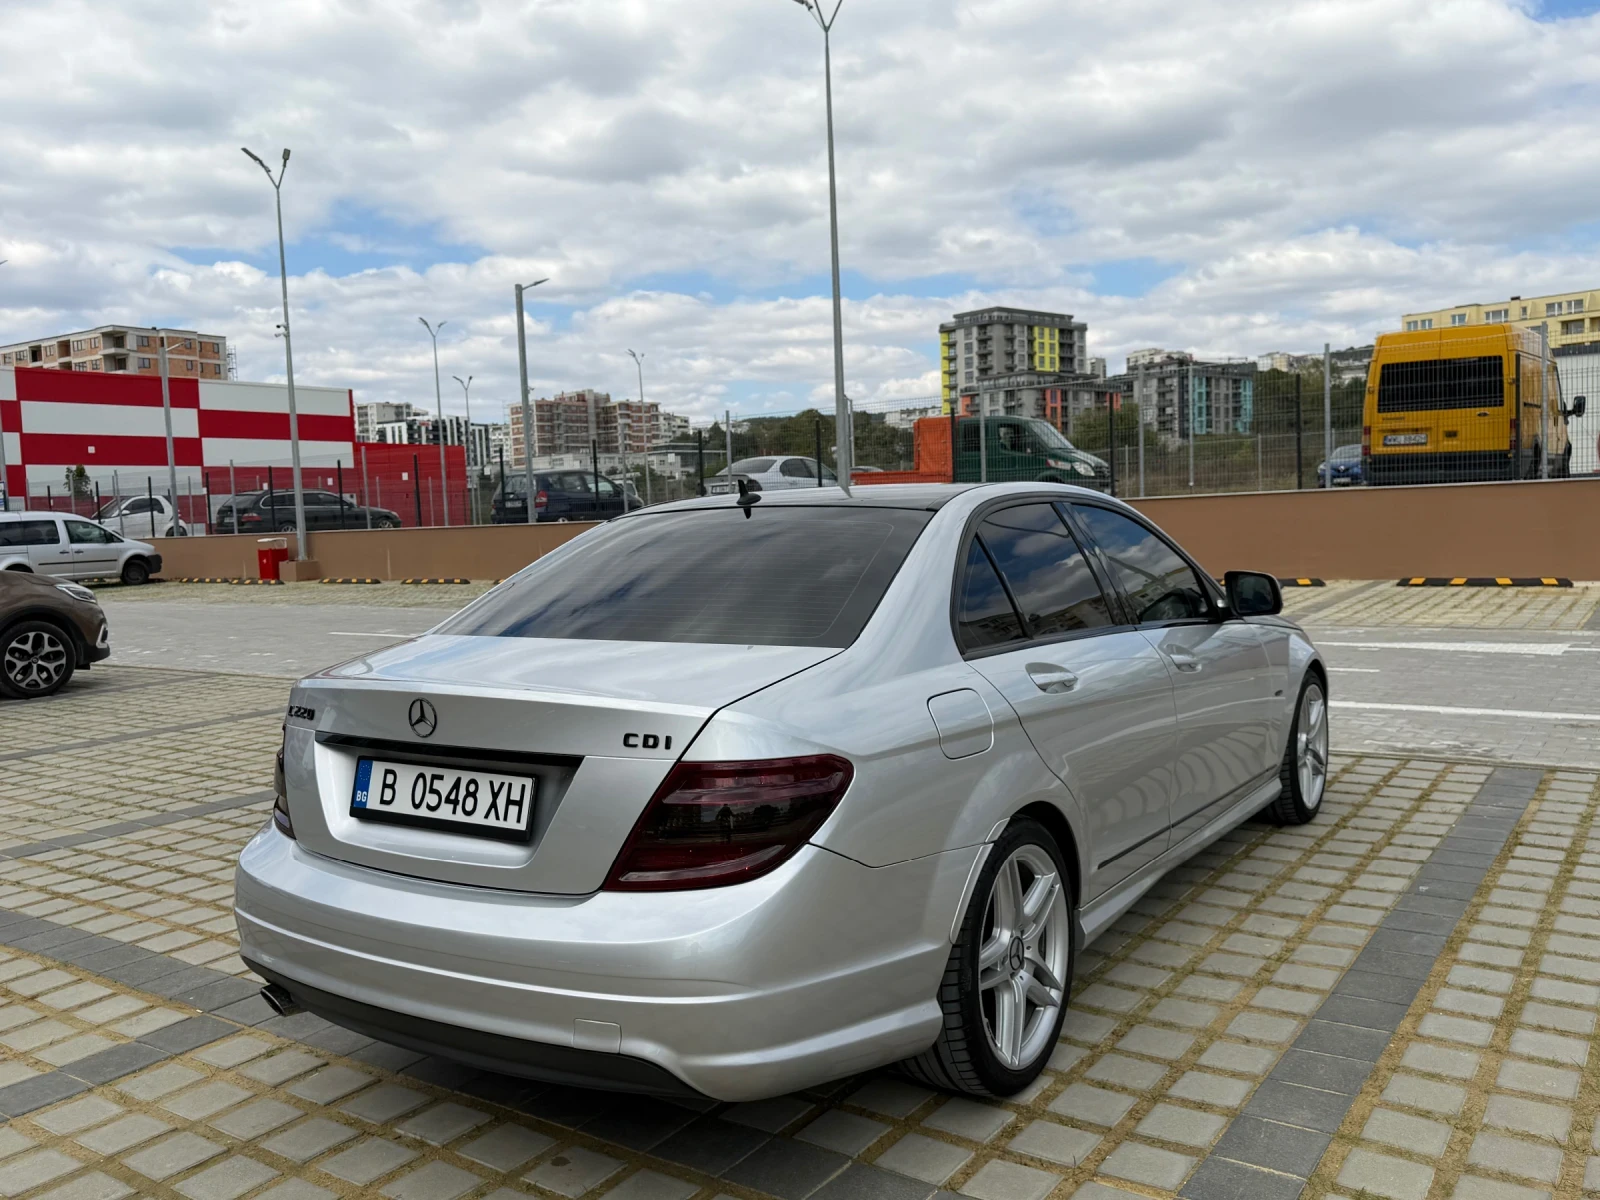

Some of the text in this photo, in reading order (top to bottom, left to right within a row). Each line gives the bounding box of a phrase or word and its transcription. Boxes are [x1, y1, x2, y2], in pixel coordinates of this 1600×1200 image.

[623, 732, 672, 750] CDI
[356, 790, 367, 802] BG
[379, 768, 526, 824] B 0548 XH
